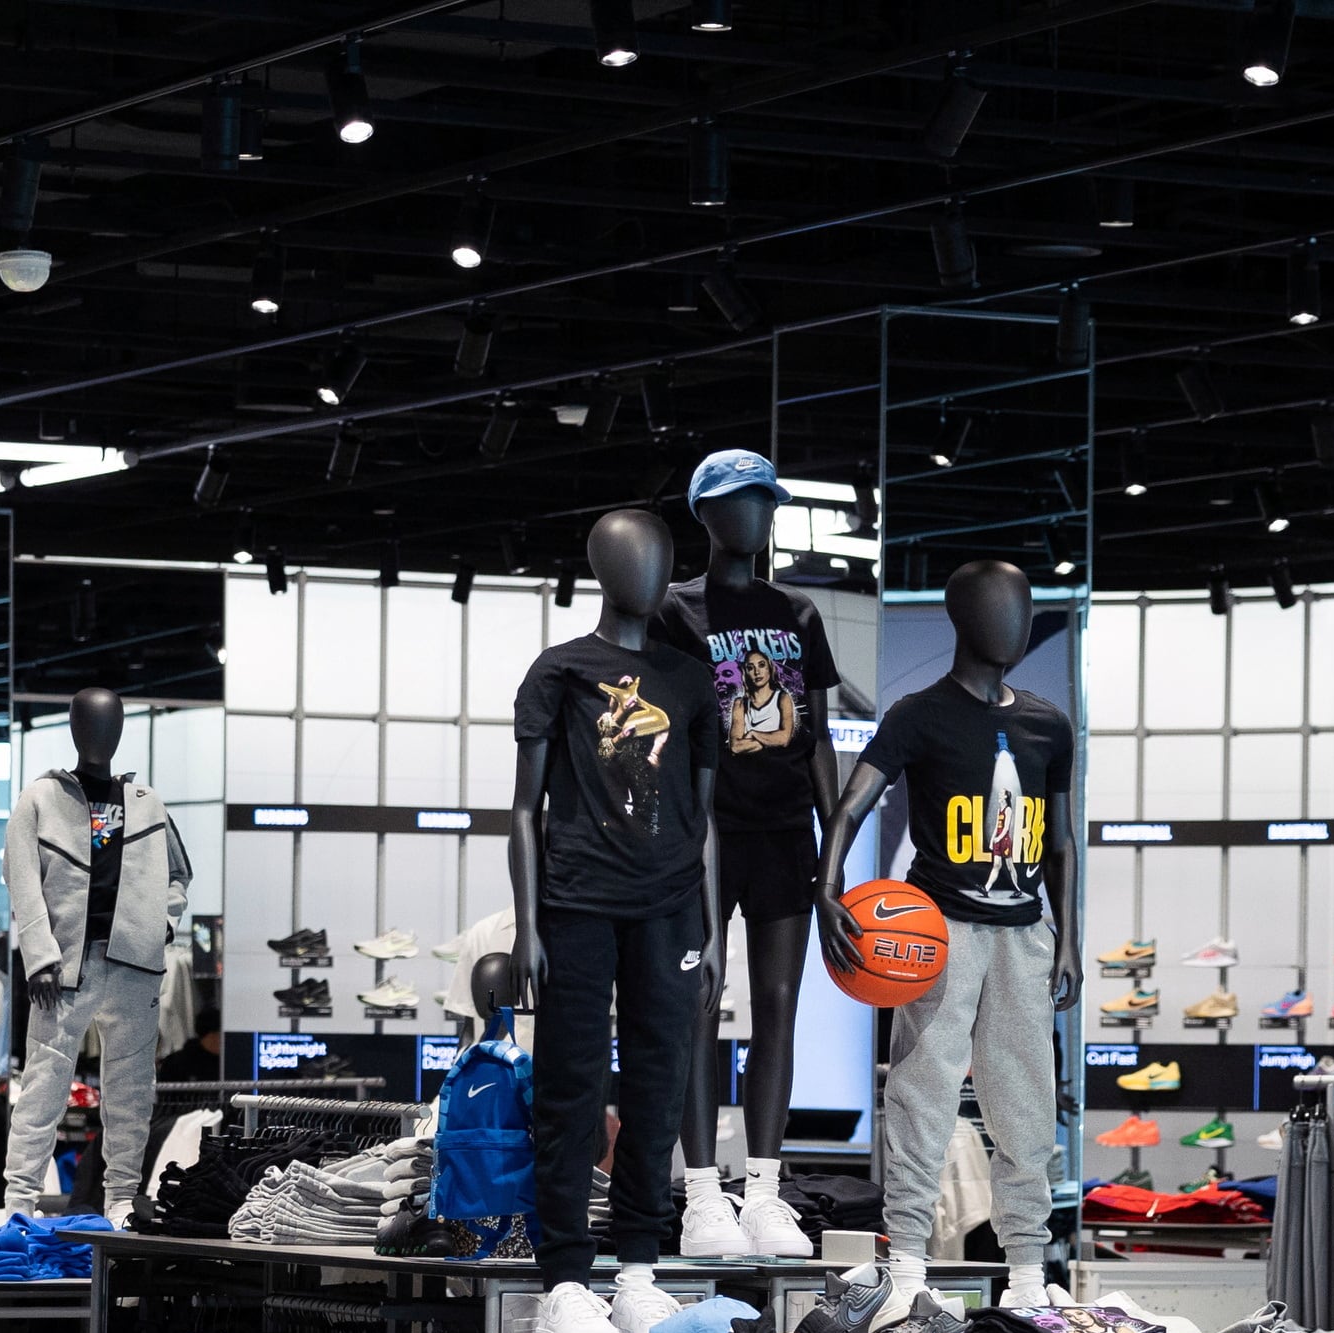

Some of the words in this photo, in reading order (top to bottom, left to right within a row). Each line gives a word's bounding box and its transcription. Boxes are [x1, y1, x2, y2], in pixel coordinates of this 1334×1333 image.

[873, 937, 938, 963] ELITE
[259, 1041, 327, 1058] Lightweight
[259, 1054, 298, 1070] Speed
